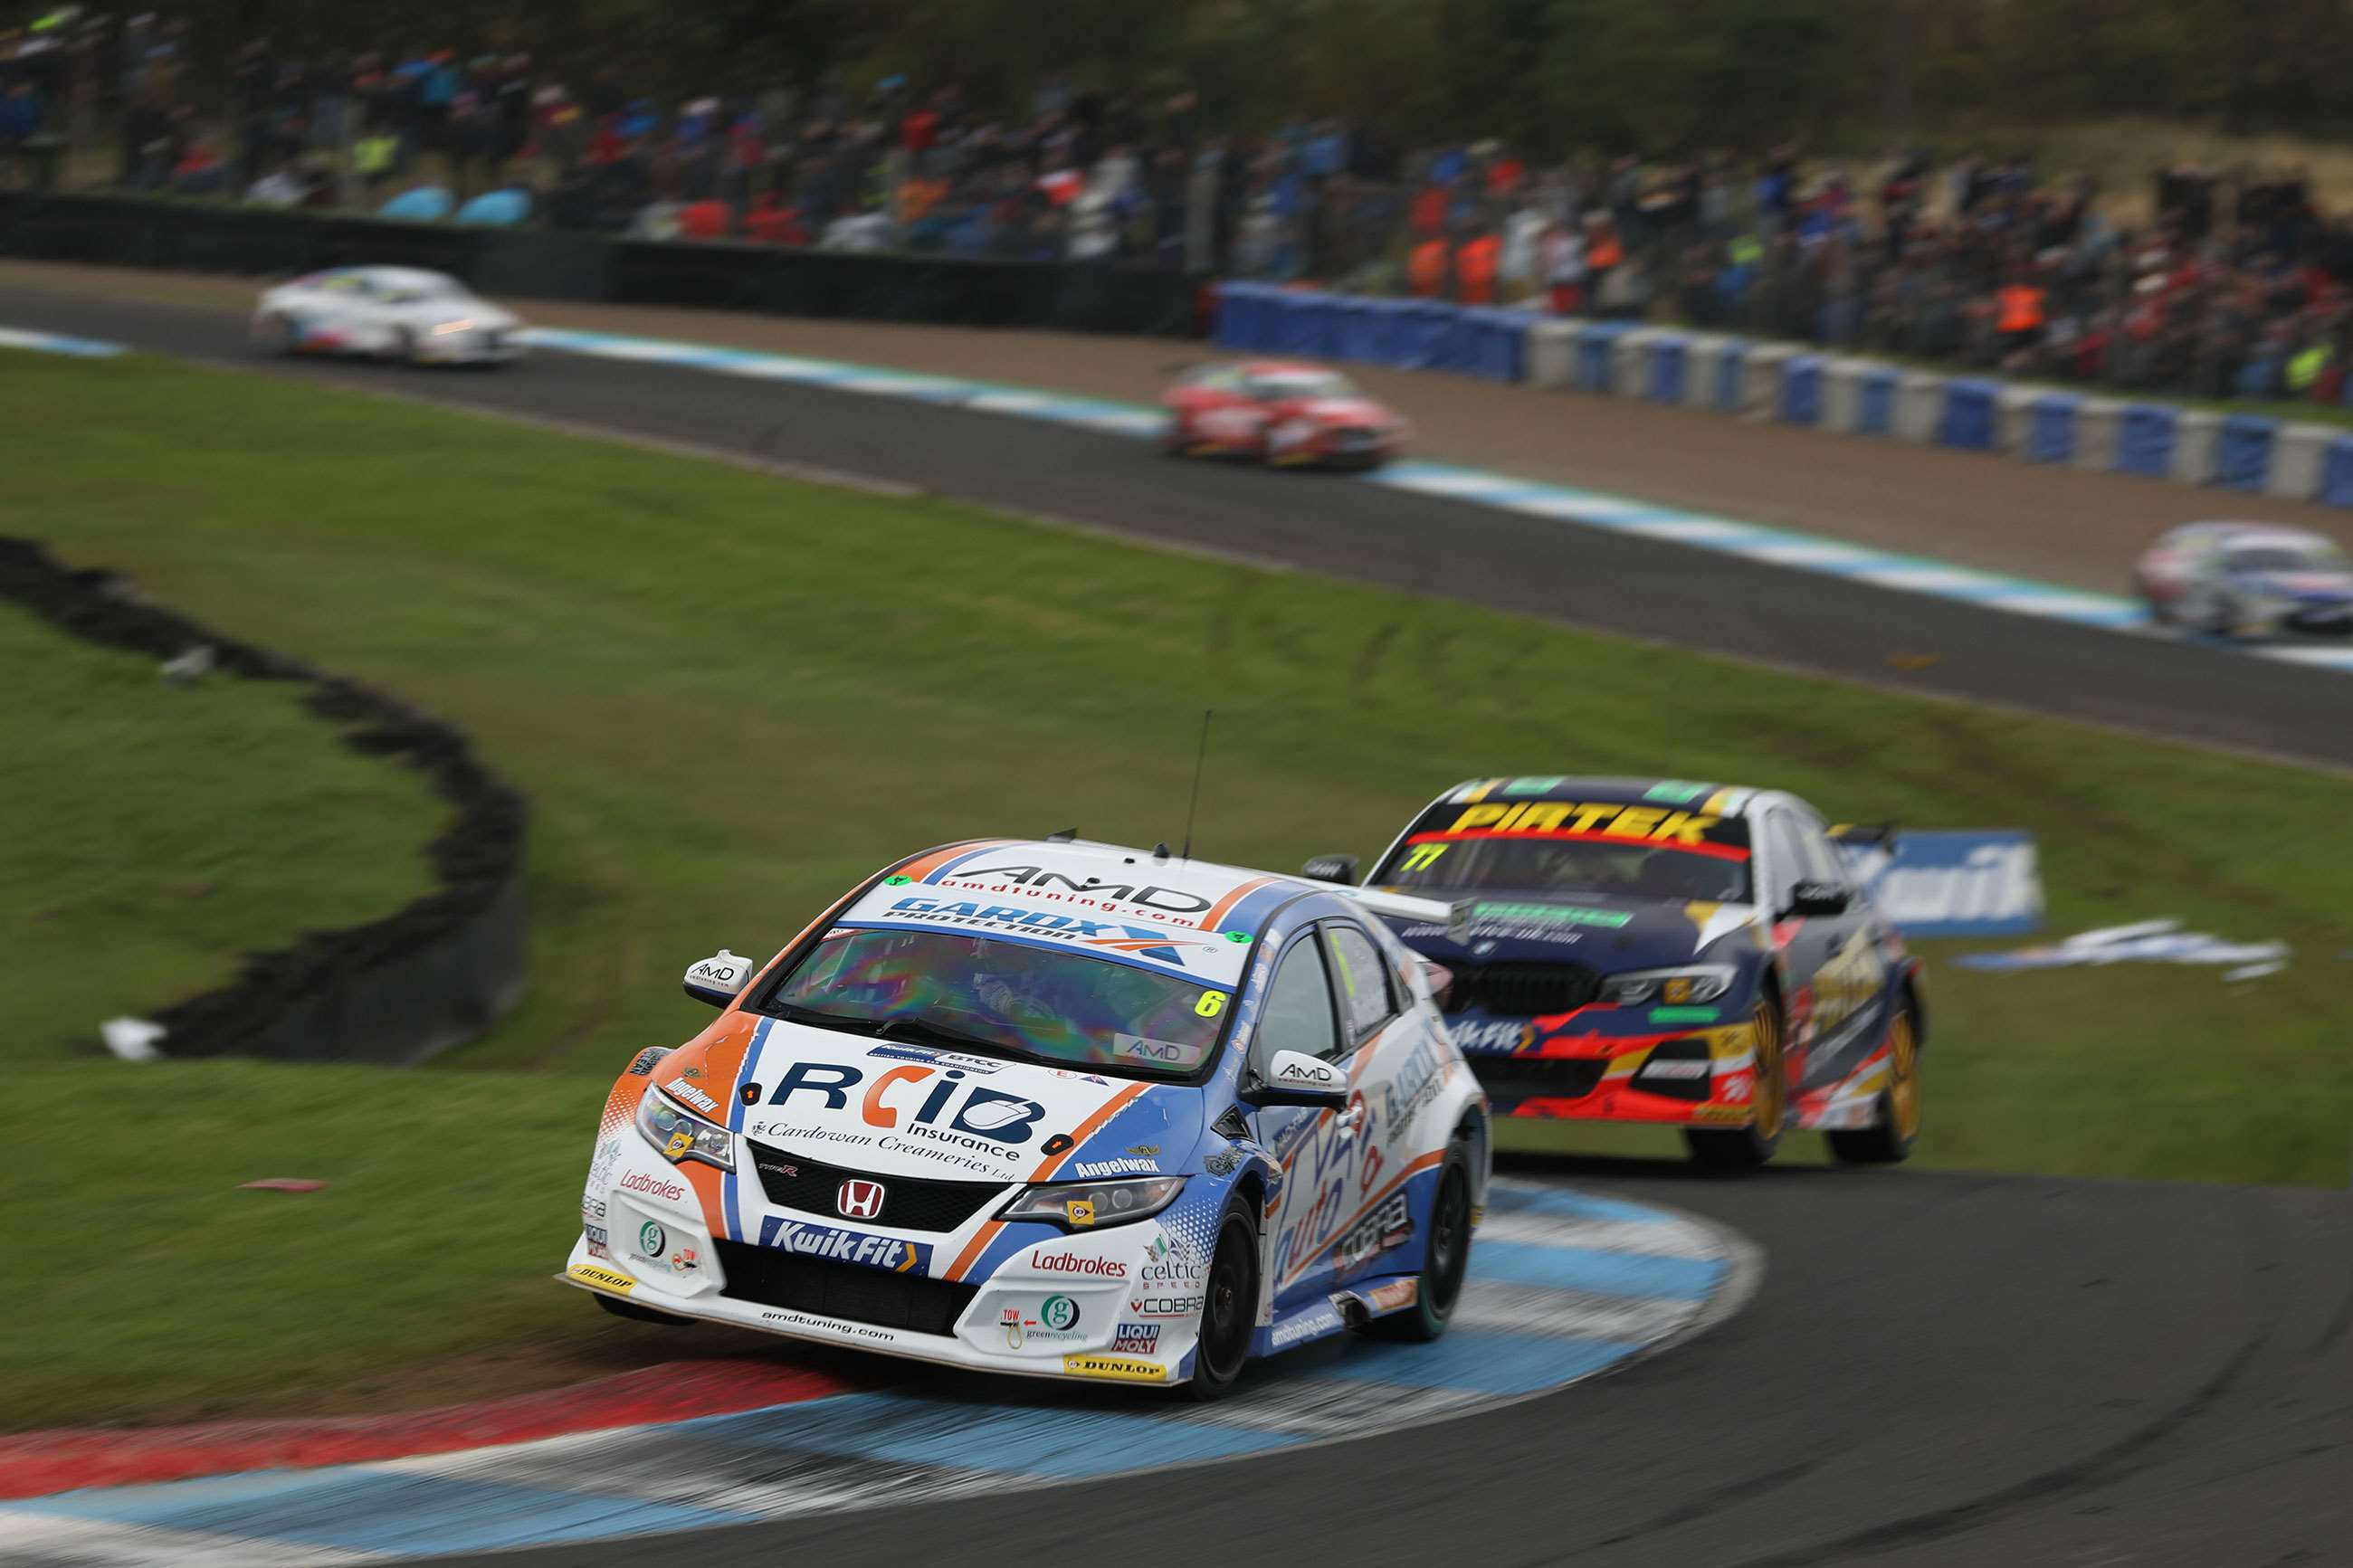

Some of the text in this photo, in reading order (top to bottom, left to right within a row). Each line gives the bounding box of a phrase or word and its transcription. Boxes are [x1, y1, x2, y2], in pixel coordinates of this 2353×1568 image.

[1400, 842, 1450, 873] 77
[941, 879, 1196, 928] amdtuning.com
[950, 866, 1213, 913] AMD
[881, 911, 1081, 940] PROTECTION
[691, 963, 735, 982] AMD
[1195, 990, 1227, 1018] 6
[948, 1054, 1003, 1068] BTCC
[1128, 1040, 1181, 1061] AMD
[1279, 1063, 1332, 1081] AMD
[665, 1077, 719, 1114] Angelwax
[768, 1122, 874, 1146] Cardowan
[879, 1136, 991, 1174] Creameries
[906, 1122, 1021, 1163] Insurance
[1075, 1157, 1160, 1178] Angelwax
[620, 1169, 685, 1201] Ladbrokes
[1032, 1250, 1127, 1278] Ladbrokes
[579, 1269, 634, 1288] DUNLOP
[761, 1312, 896, 1342] amdtuning.com
[1003, 1310, 1020, 1321] TOW
[1119, 1325, 1159, 1339] LIQUI
[1113, 1339, 1156, 1354] MOLY
[1084, 1361, 1160, 1374] DUNLOP
